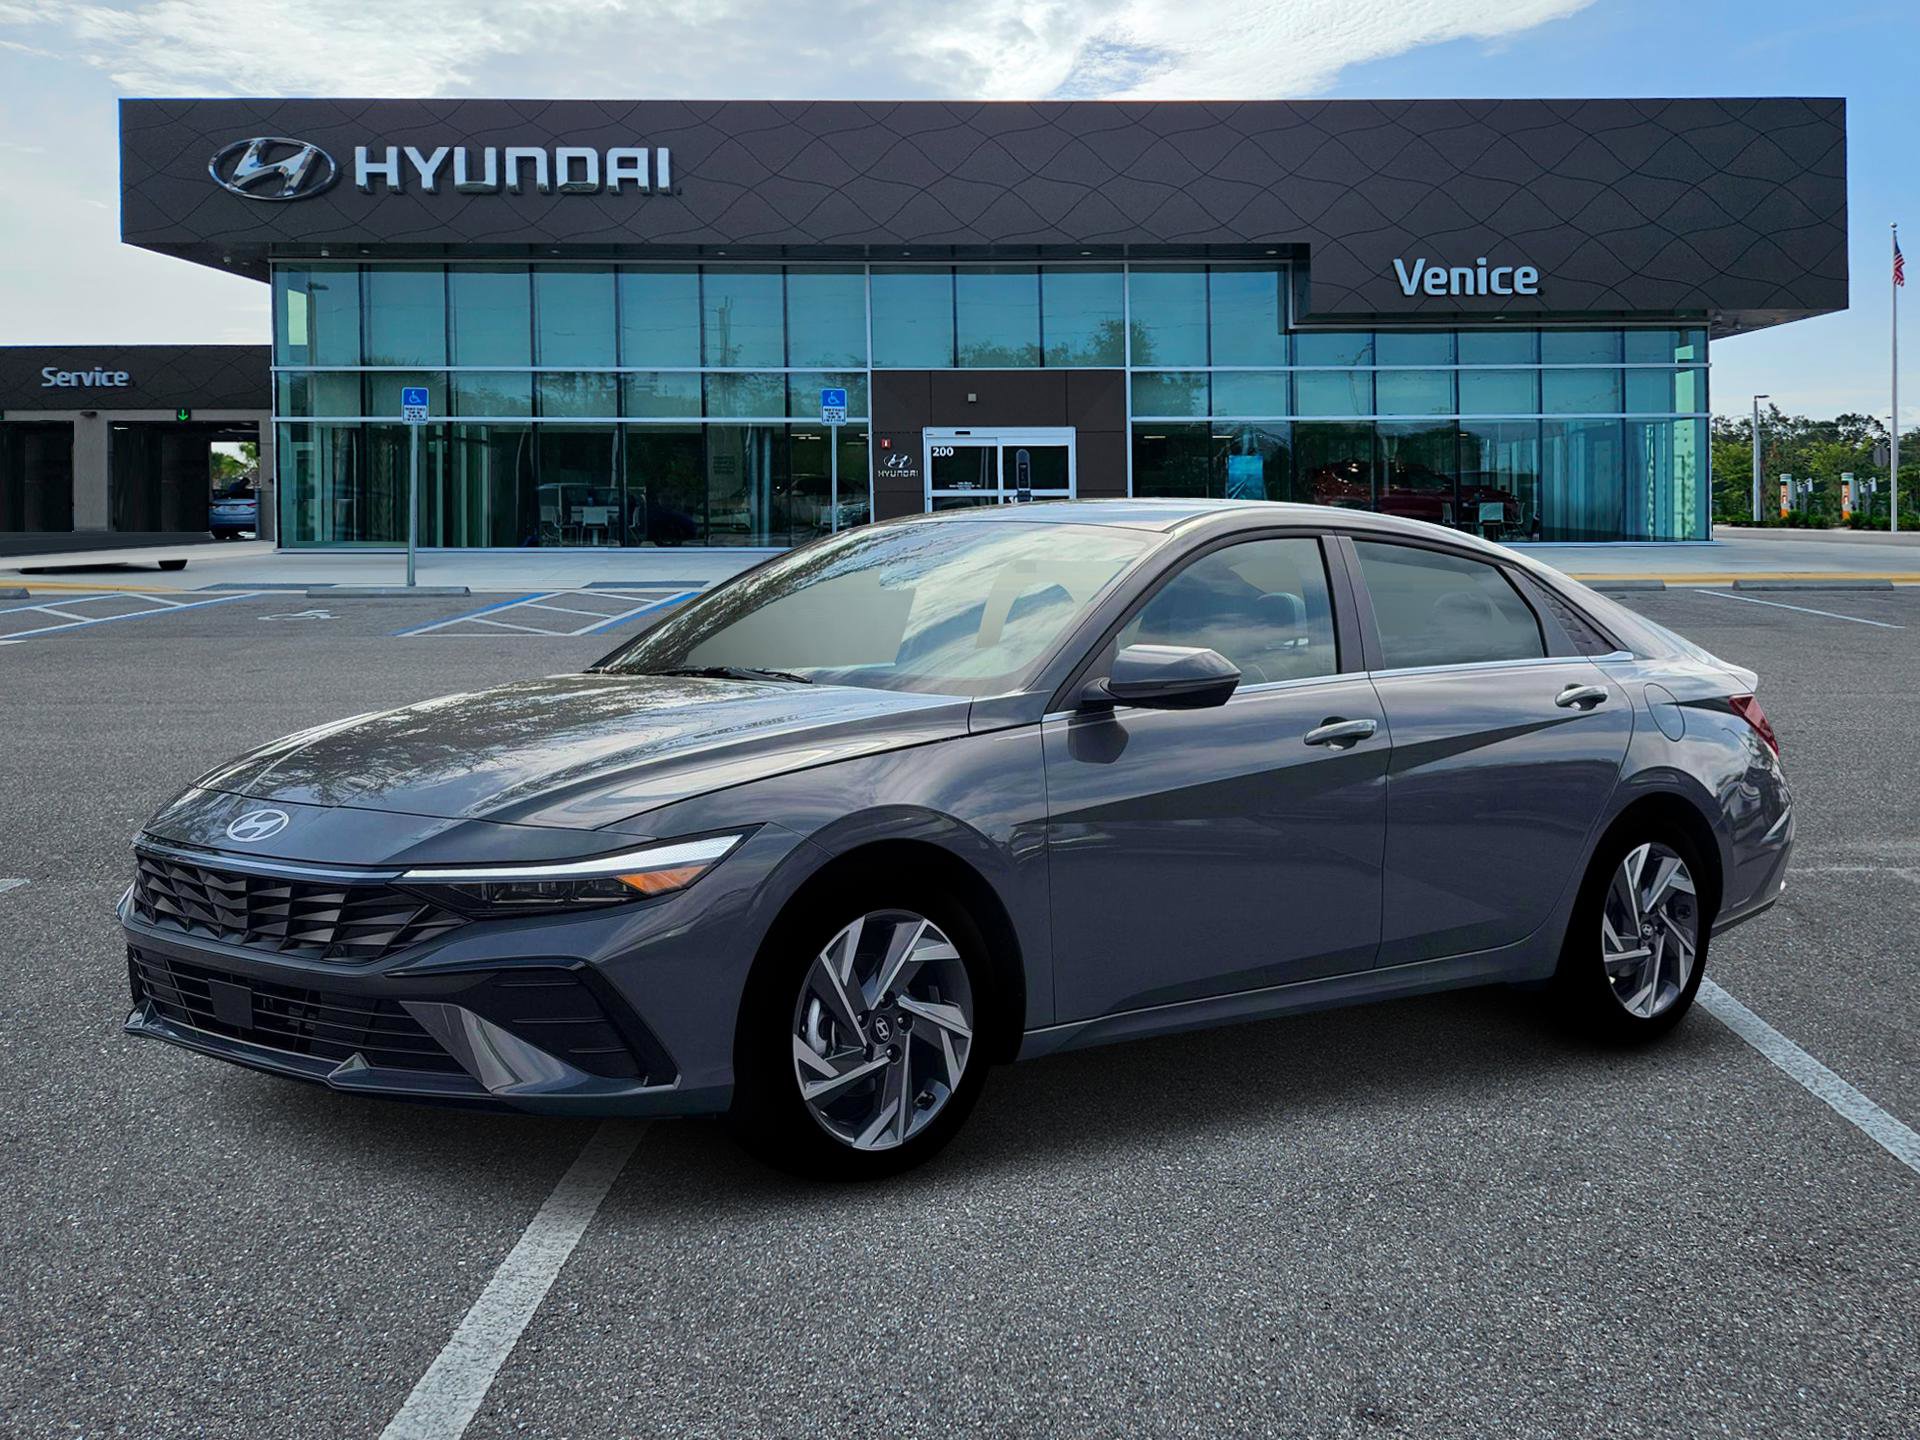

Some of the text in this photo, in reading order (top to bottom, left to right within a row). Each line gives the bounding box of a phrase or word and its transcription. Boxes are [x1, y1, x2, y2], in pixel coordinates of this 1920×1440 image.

[354, 146, 671, 194] HYUNDAI
[1393, 257, 1539, 296] Venice
[41, 366, 129, 387] Service
[932, 446, 954, 457] 200
[877, 469, 919, 478] HYUNDAI
